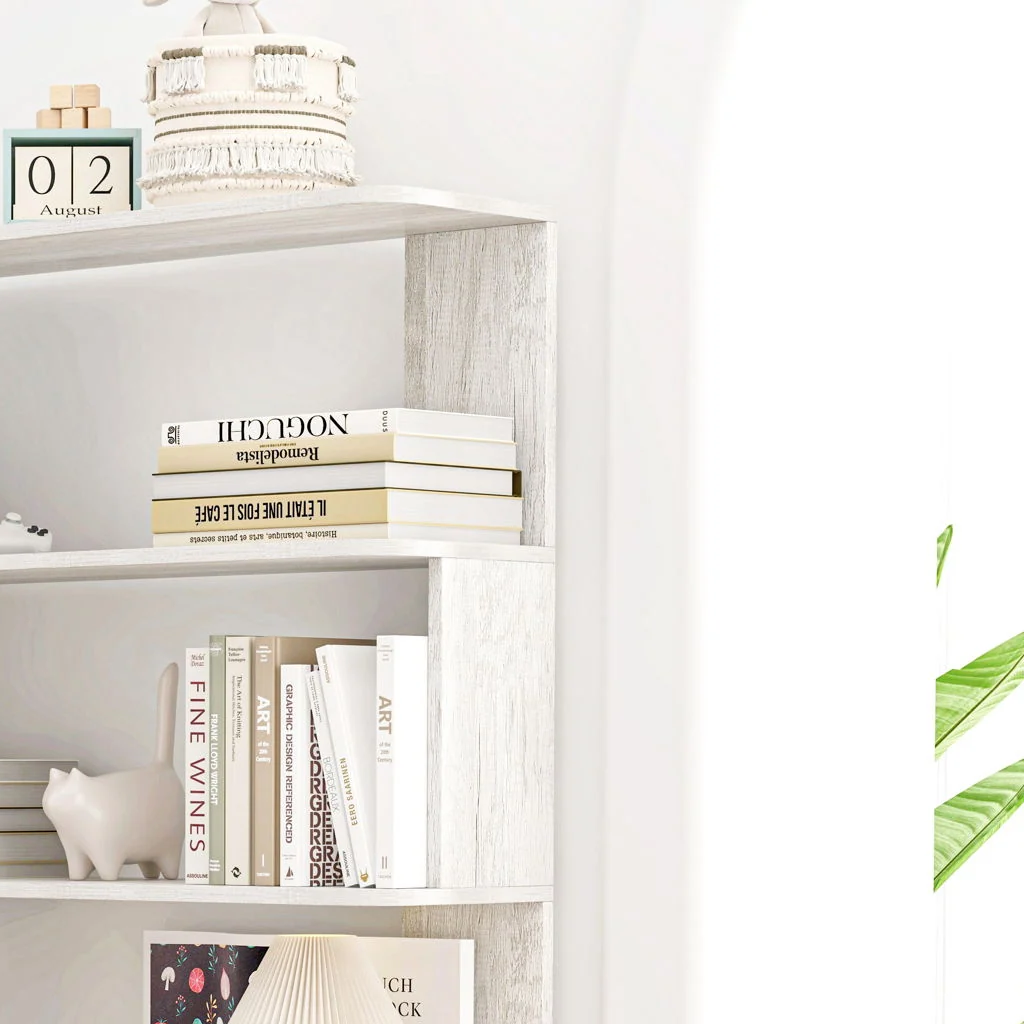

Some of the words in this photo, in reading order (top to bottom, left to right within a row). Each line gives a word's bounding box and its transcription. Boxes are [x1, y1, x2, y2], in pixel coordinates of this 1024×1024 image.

[40, 204, 102, 218] August
[218, 413, 348, 442] NOGUCHI
[237, 446, 319, 464] Remodelista
[195, 505, 220, 526] CAFÉ
[223, 504, 234, 521] LE
[238, 503, 259, 520] FOIS
[263, 501, 282, 519] UNE
[286, 500, 314, 520] ÉTAIT
[317, 499, 326, 516] IL
[190, 681, 206, 743] FINE
[257, 695, 270, 735] ART
[285, 684, 293, 731] GRAPHIC
[378, 695, 392, 735] ART
[285, 734, 293, 771] DESIGN
[189, 758, 206, 851] WINES
[285, 775, 293, 844] REFERENCED
